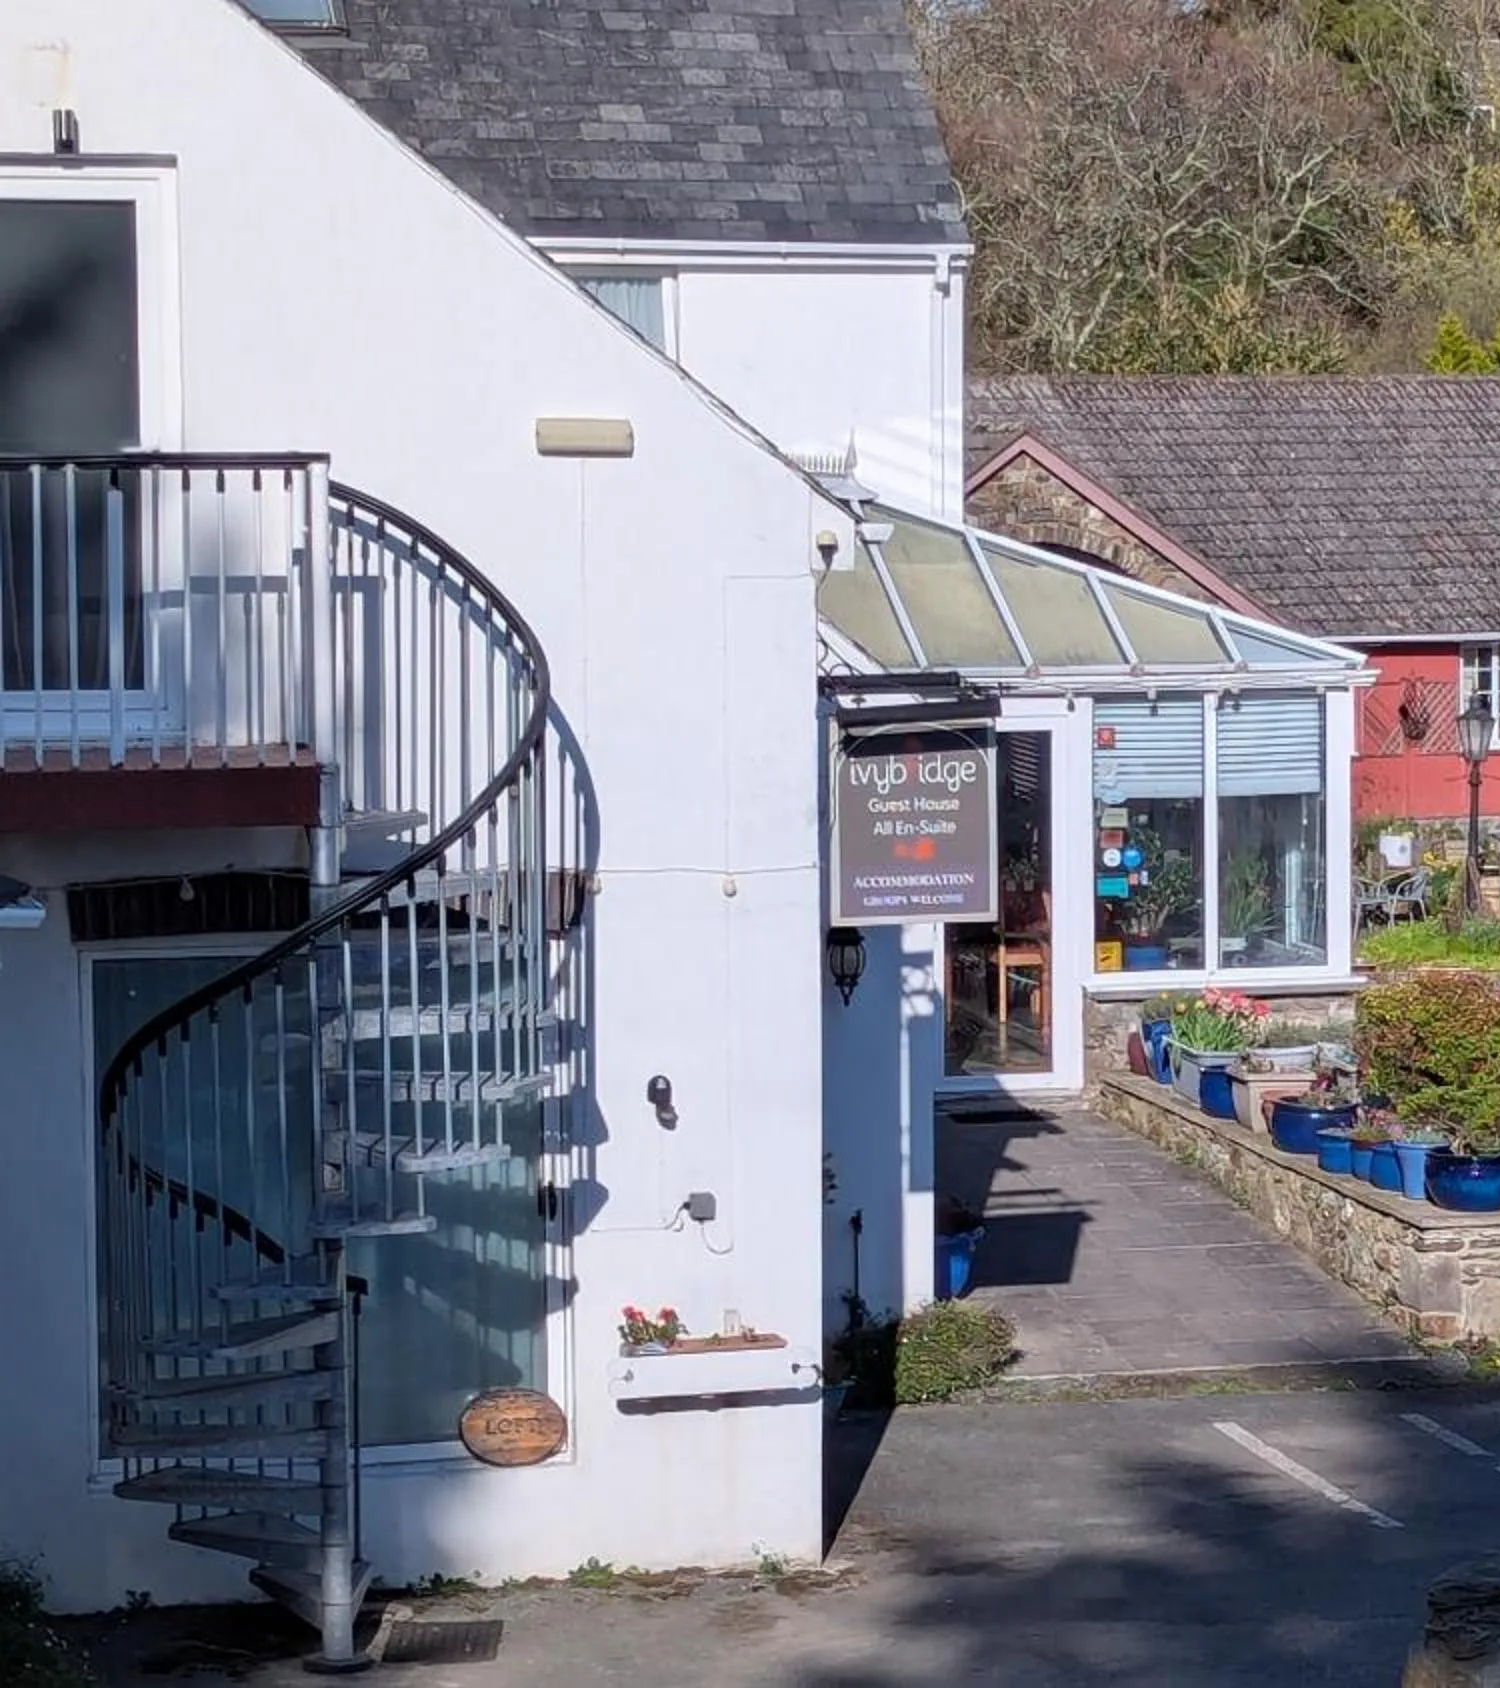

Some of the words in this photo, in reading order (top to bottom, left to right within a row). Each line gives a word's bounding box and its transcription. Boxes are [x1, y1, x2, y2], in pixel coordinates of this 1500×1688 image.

[849, 754, 977, 794] ivybidge
[868, 798, 911, 813] Guest
[914, 797, 960, 811] House
[873, 821, 893, 835] All
[895, 820, 957, 835] En-Suite
[854, 872, 975, 889] ACCOMMODATION
